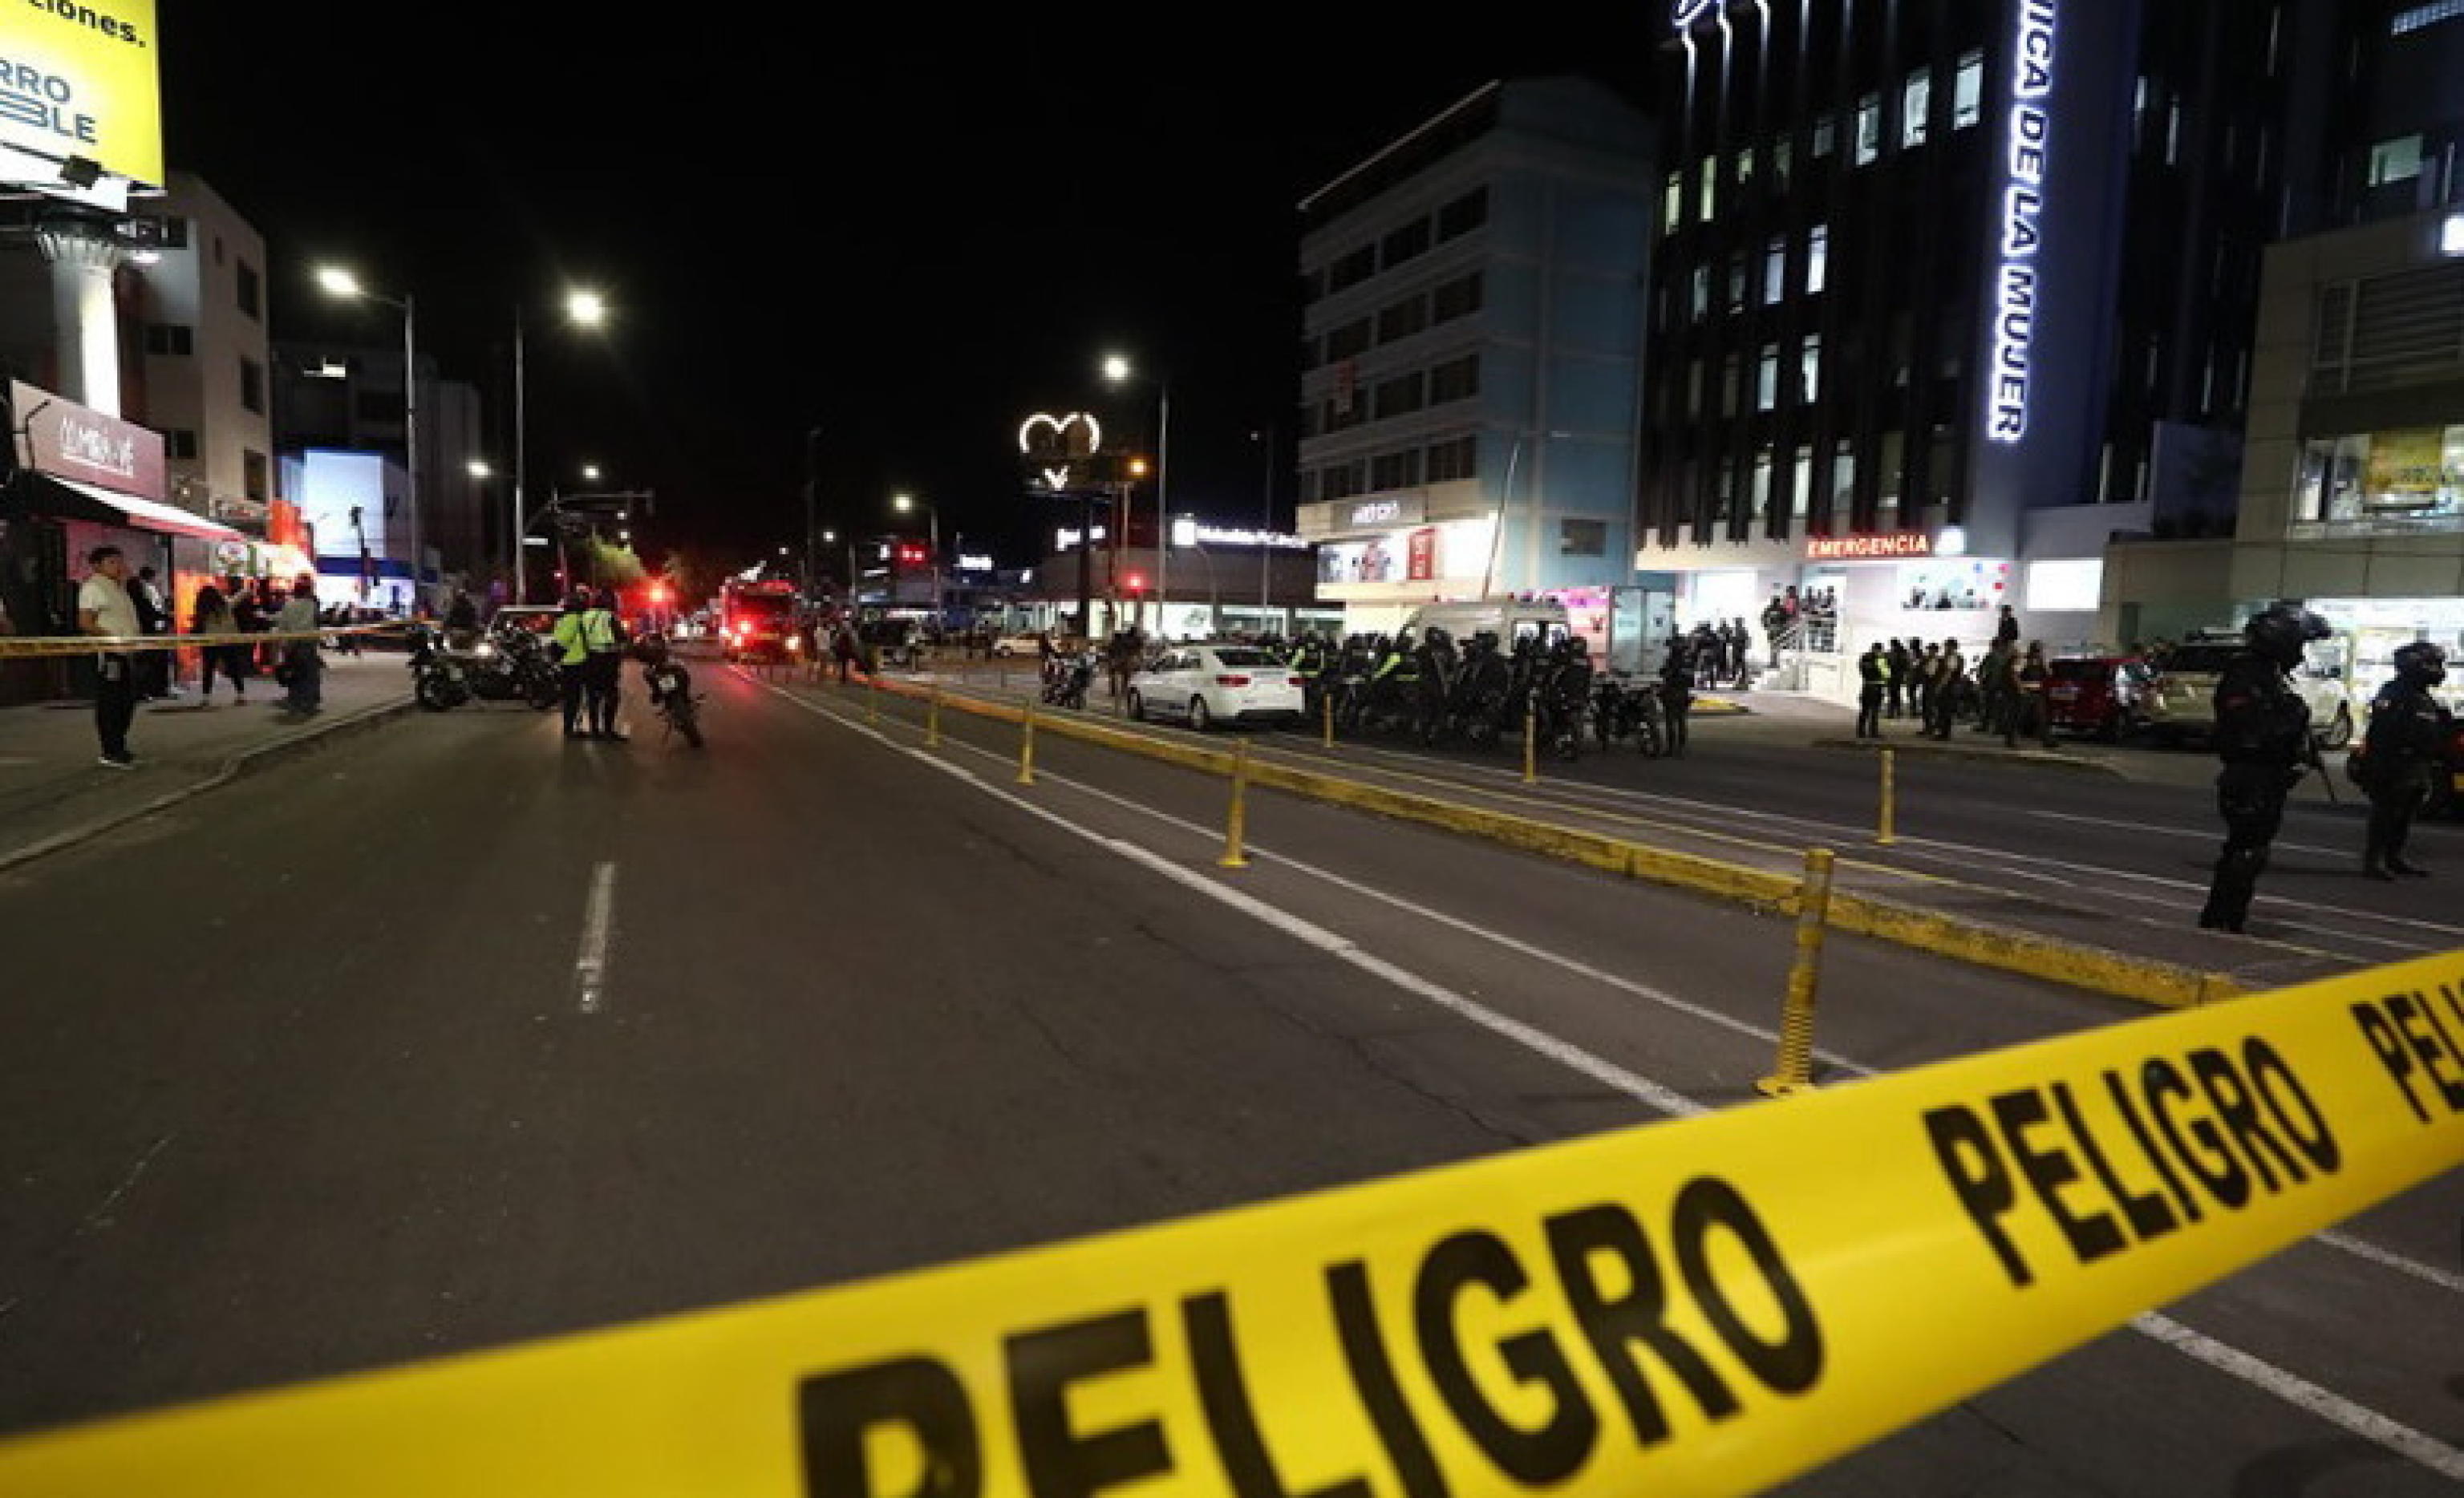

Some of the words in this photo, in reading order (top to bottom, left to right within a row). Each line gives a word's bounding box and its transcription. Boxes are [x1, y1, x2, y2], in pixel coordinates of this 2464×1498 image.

[2015, 108, 2046, 178] DE
[2008, 188, 2040, 253] LA
[1994, 267, 2036, 437] MUJER
[1807, 534, 1931, 558] EMERGENCIA
[1922, 1036, 2341, 1287] PELIGRO
